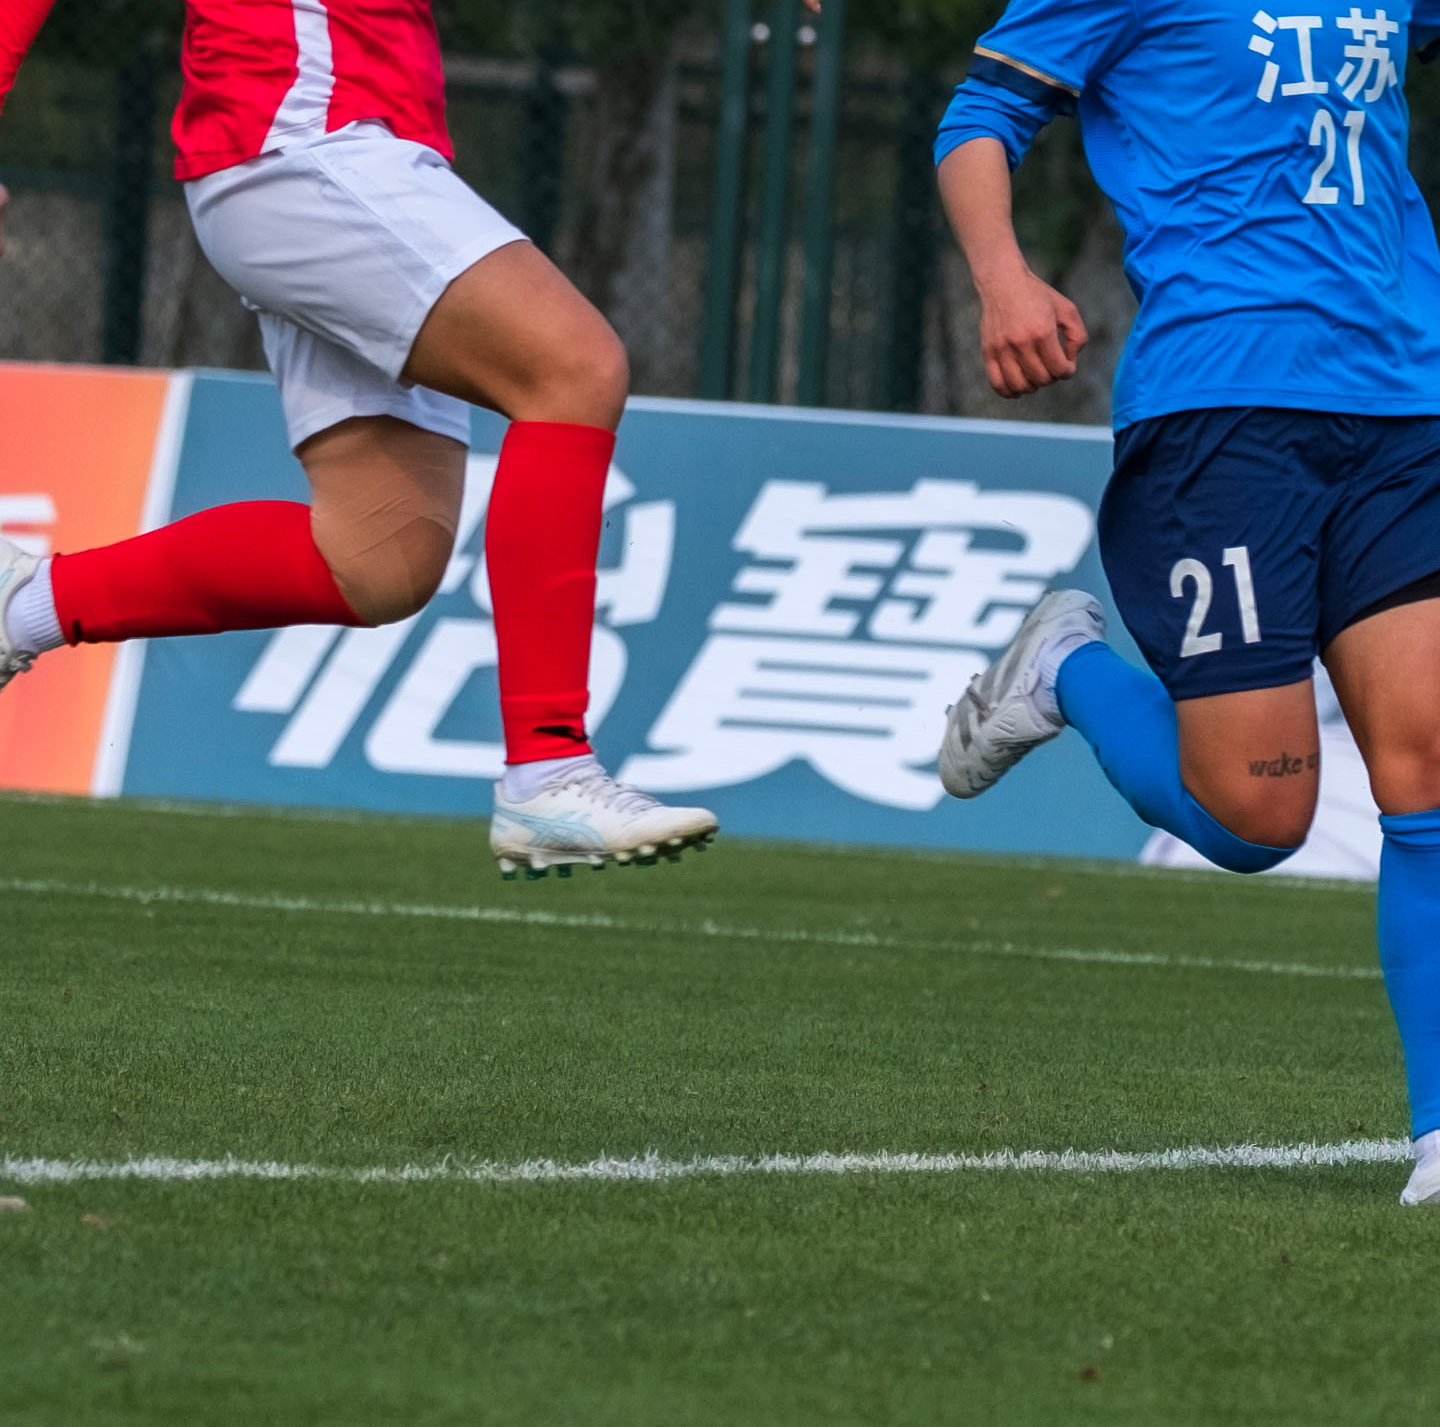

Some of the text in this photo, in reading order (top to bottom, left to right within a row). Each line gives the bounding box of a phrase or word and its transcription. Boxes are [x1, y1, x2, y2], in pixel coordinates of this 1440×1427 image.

[1248, 7, 1400, 104] 江苏
[1302, 109, 1366, 206] 21
[1169, 545, 1263, 659] 21
